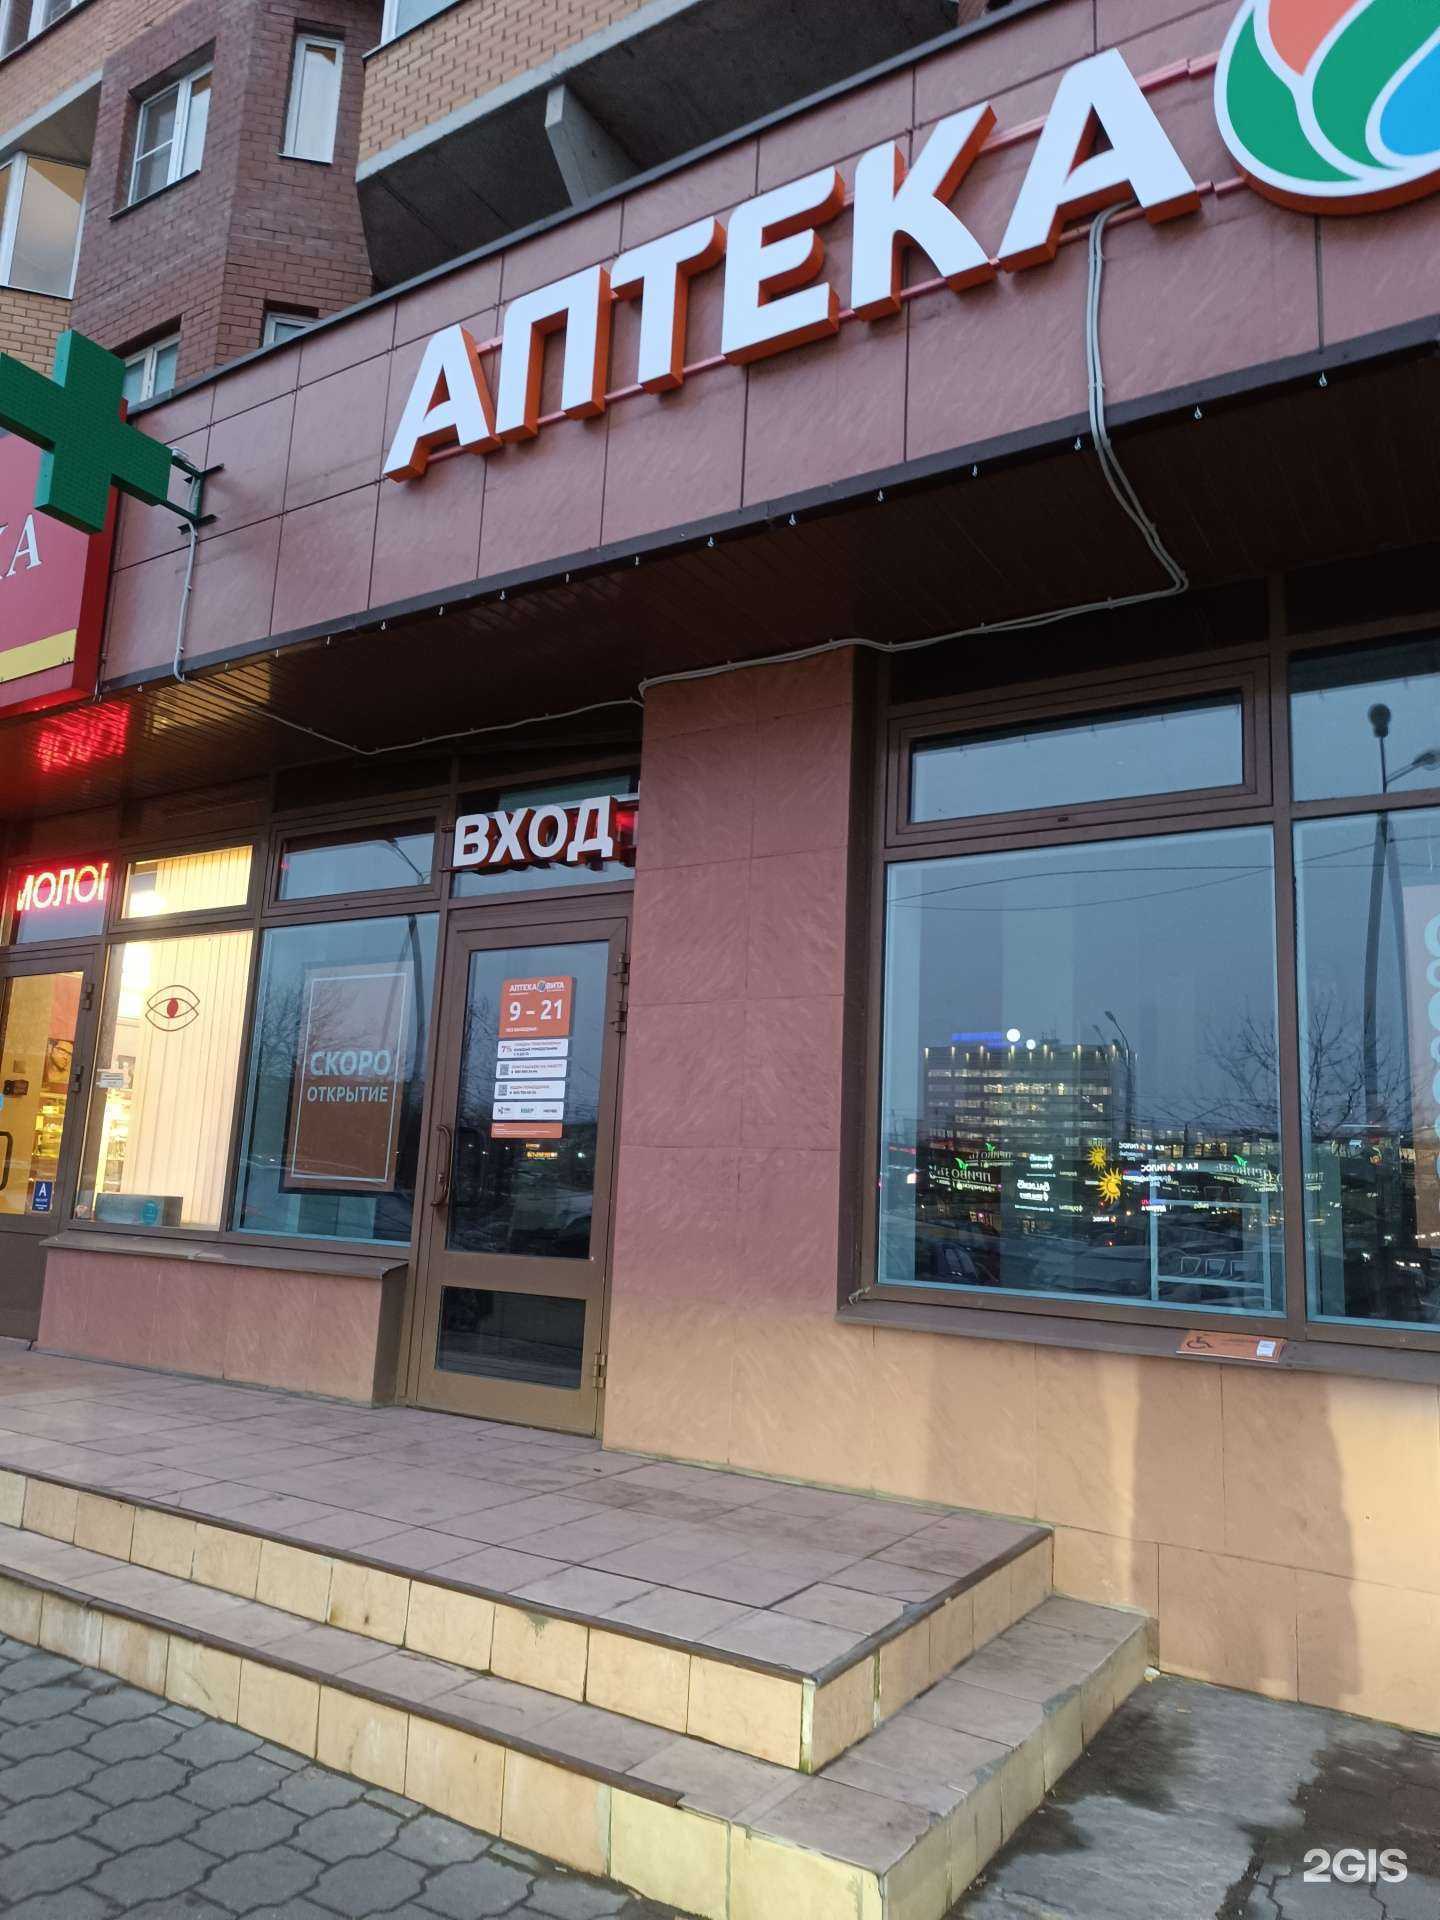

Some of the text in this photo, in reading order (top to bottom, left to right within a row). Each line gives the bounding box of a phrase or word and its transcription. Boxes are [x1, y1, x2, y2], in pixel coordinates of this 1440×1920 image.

[383, 48, 1198, 480] АПТЕКА
[0, 514, 42, 579] А
[453, 795, 614, 868] ВХОД
[509, 1001, 521, 1021] 9
[540, 999, 562, 1020] 21
[310, 1050, 391, 1076] СКОРО
[307, 1086, 388, 1102] ОТКРЫТИЕ
